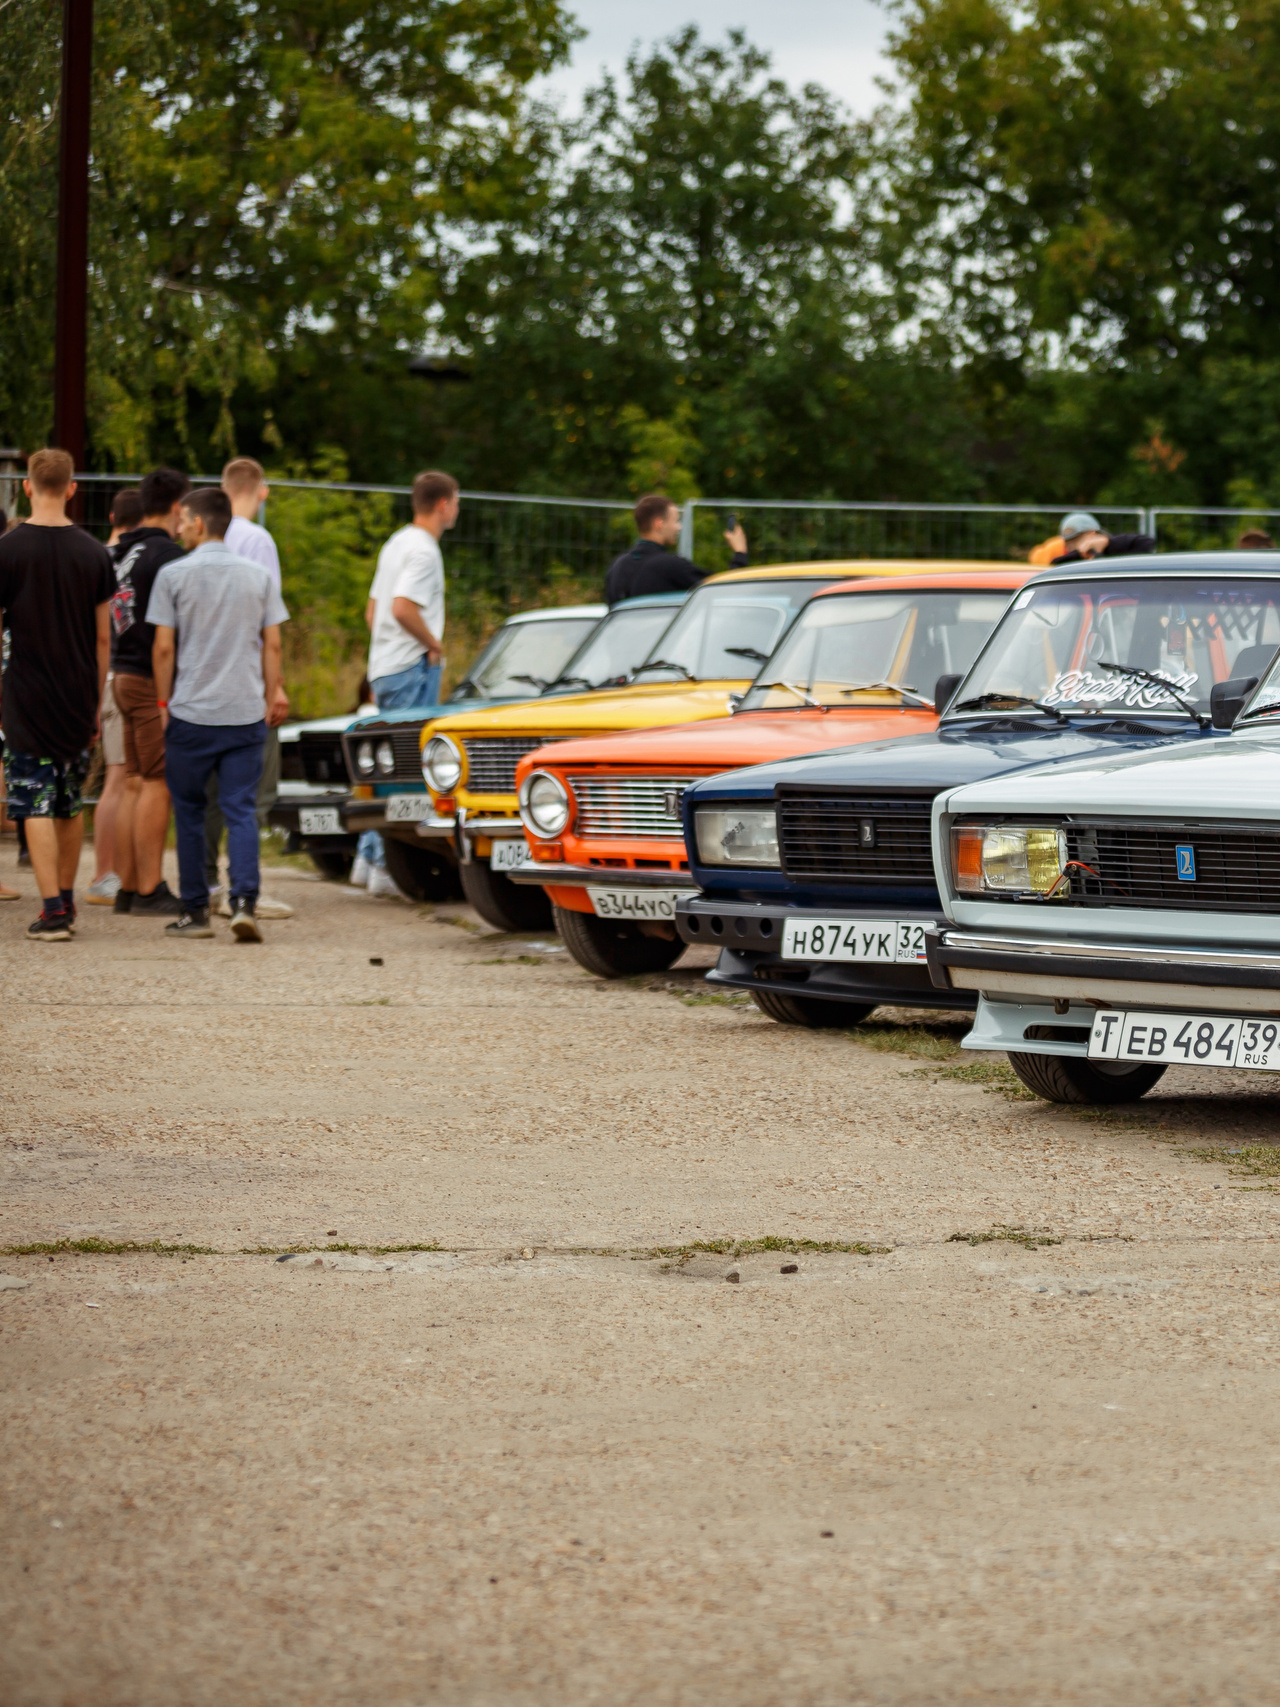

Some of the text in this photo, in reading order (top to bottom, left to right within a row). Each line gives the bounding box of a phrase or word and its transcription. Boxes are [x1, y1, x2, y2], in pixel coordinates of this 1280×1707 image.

[792, 925, 925, 957] Н874УК 32
[897, 949, 916, 959] RUS
[1242, 1022, 1278, 1053] 39
[1243, 1053, 1269, 1066] RUS
